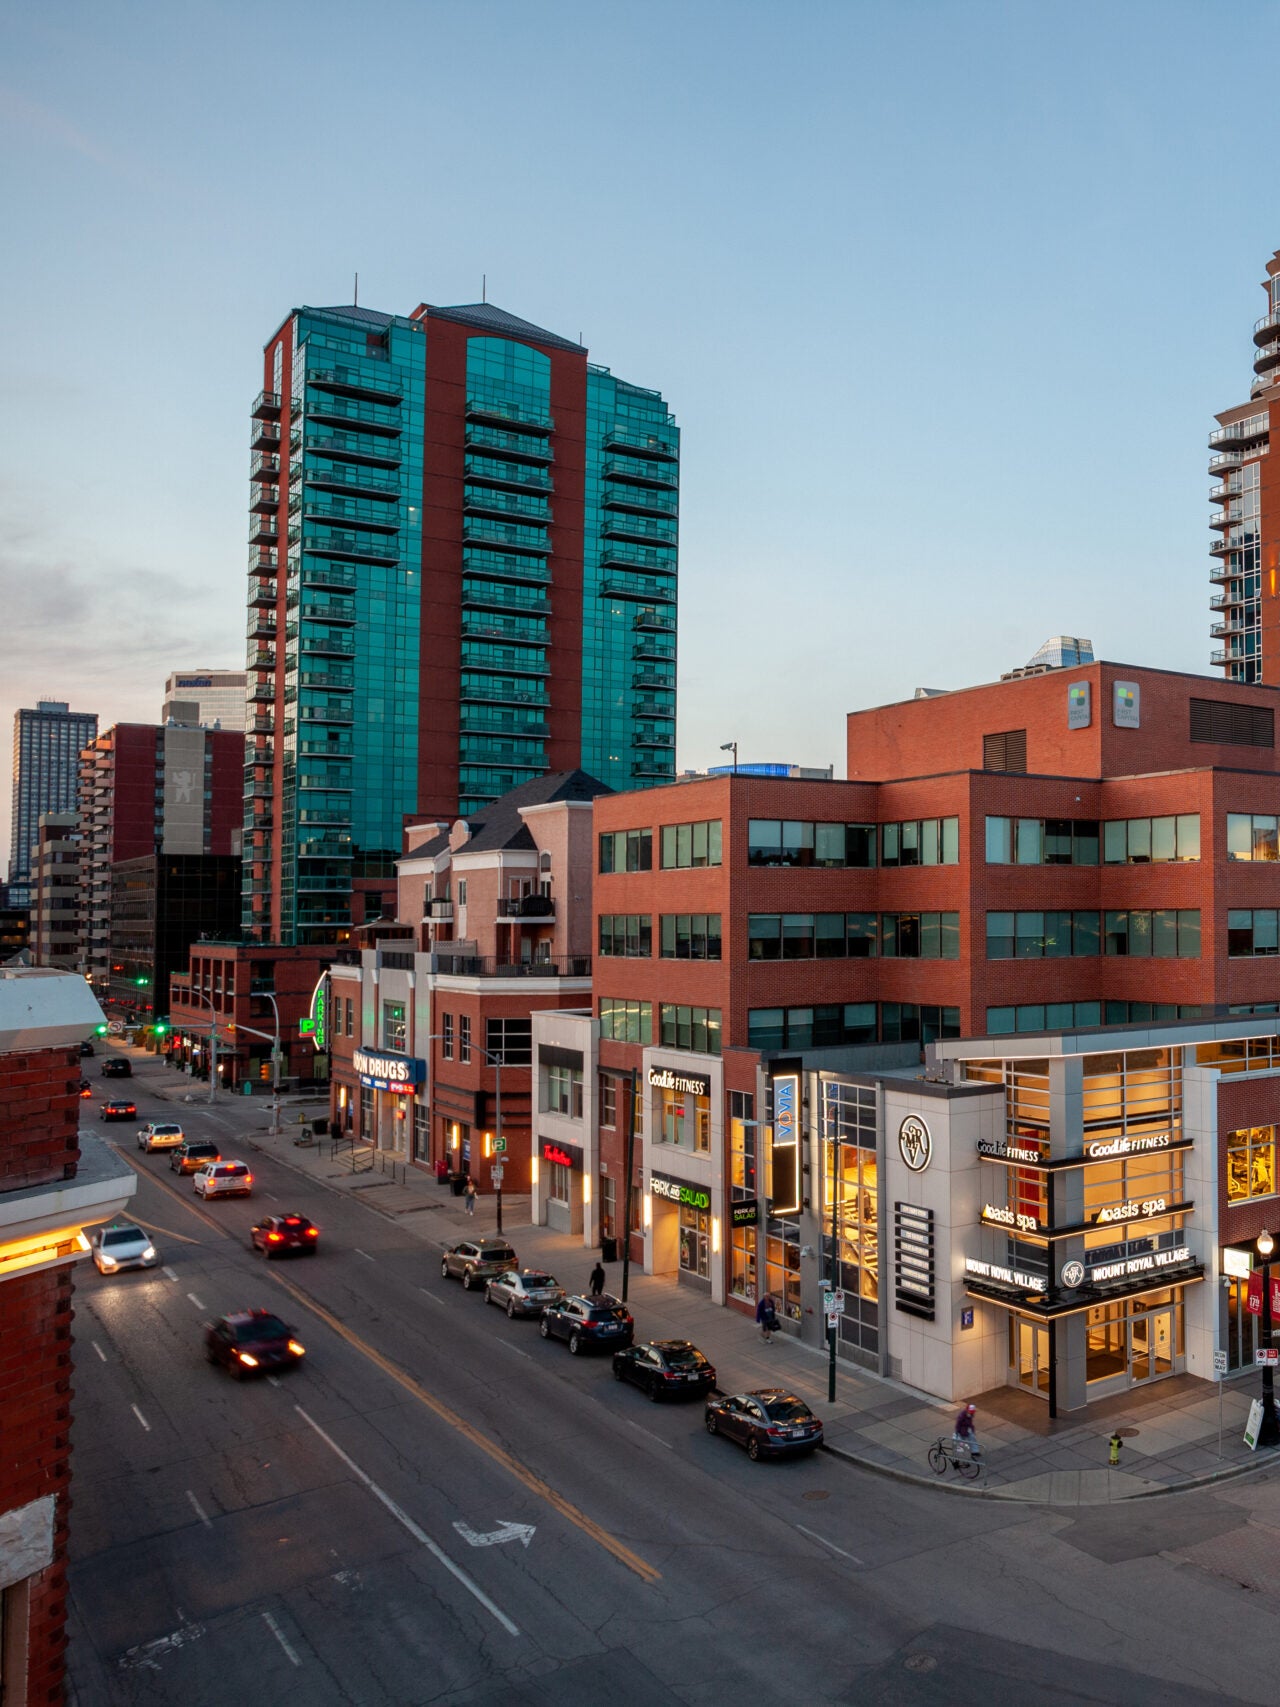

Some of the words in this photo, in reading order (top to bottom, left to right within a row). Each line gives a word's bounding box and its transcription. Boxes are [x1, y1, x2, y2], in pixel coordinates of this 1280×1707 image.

[301, 1019, 315, 1033] P
[317, 990, 325, 1044] PARKING
[369, 1058, 410, 1081] DRUGS
[648, 1068, 675, 1090] GoodLife
[675, 1077, 705, 1096] FITNESS
[778, 1084, 793, 1137] VOVIA
[977, 1139, 1007, 1157] GoodLife
[1007, 1147, 1039, 1162] FITNESS
[1089, 1137, 1131, 1157] GoodLife
[1131, 1134, 1169, 1151] FITNESS
[650, 1178, 670, 1197] FORK
[670, 1186, 680, 1198] AND
[680, 1187, 709, 1209] SALAD
[734, 1213, 756, 1221] SALAD
[988, 1206, 1015, 1224] oasis
[1016, 1213, 1037, 1232] spa
[1104, 1200, 1138, 1222] oasis
[1142, 1198, 1166, 1217] spa
[965, 1258, 991, 1276] MOUNT
[990, 1264, 1013, 1283] ROYAL
[1013, 1271, 1047, 1292] VILLAGE
[1092, 1263, 1126, 1282] MOUNT
[1127, 1256, 1154, 1274] ROYAL
[1154, 1247, 1190, 1266] VILLAGE
[1215, 1357, 1226, 1366] ONE
[1215, 1364, 1226, 1372] WAY
